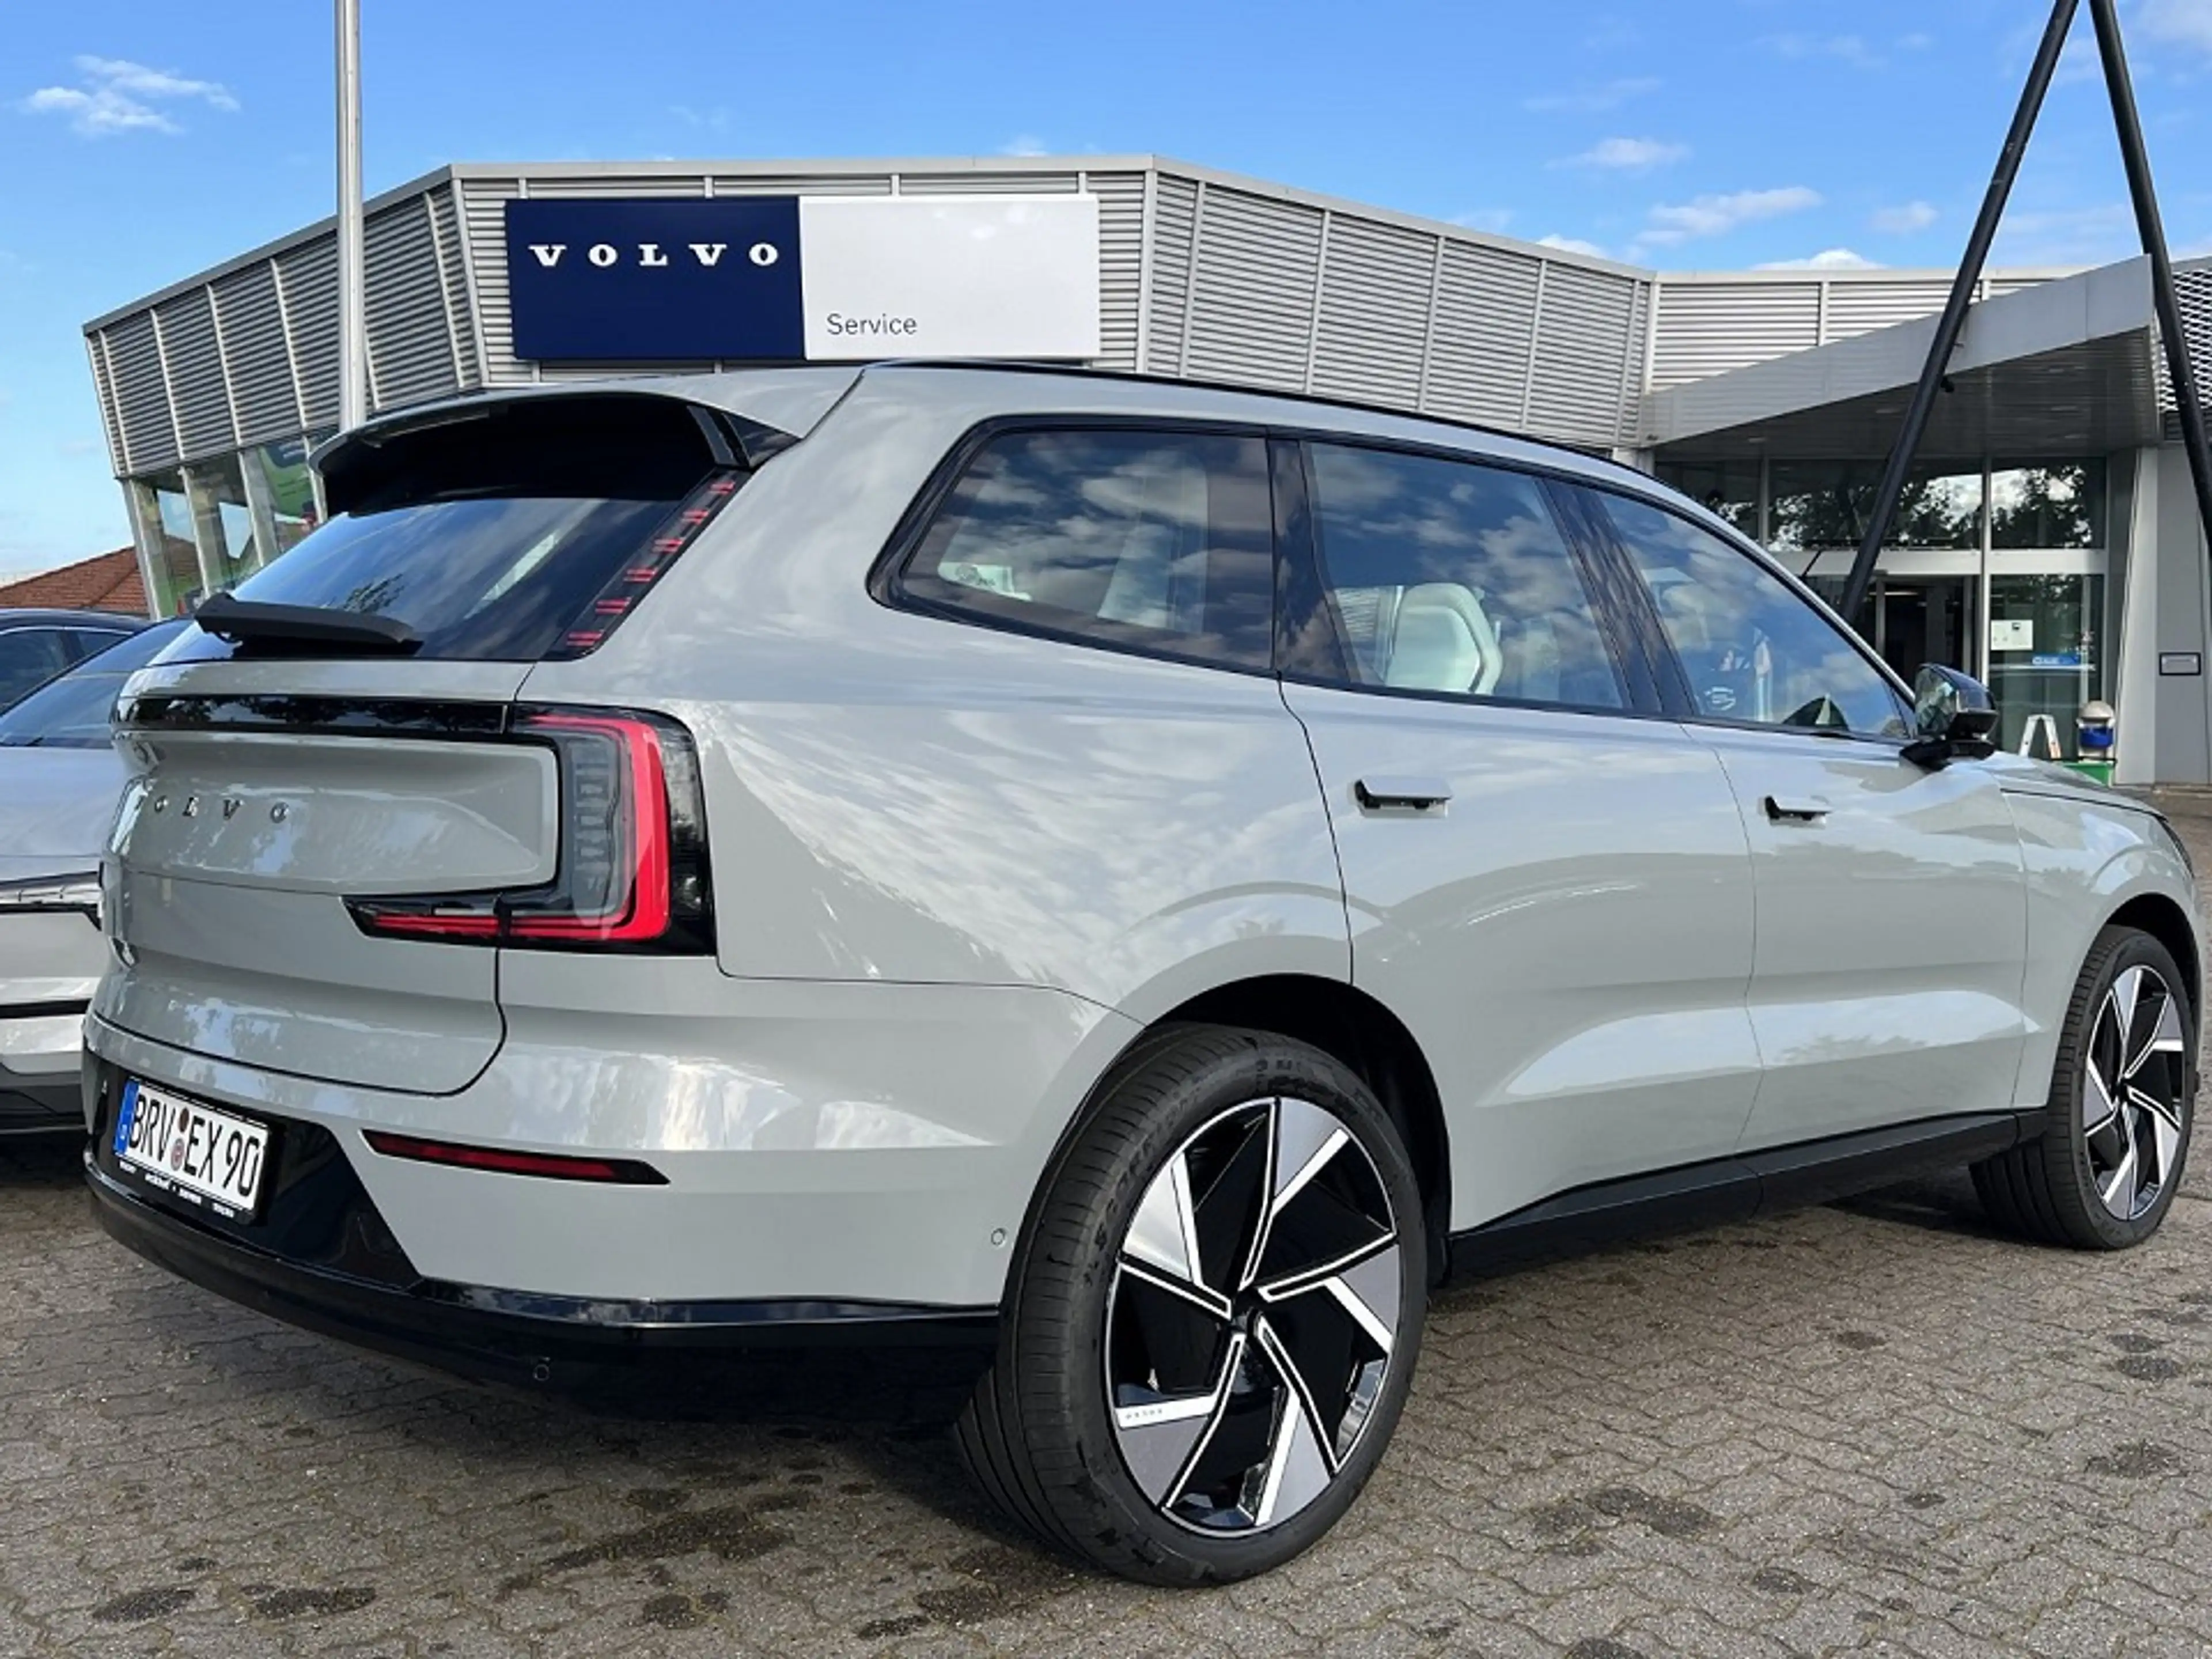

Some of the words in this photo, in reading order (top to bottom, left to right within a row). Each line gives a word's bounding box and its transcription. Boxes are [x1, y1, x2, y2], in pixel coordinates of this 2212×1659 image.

[528, 243, 779, 267] VOLVO
[827, 313, 917, 335] Service
[137, 795, 289, 823] OLVO
[129, 1095, 176, 1162] BRV
[184, 1115, 223, 1183] EX
[222, 1130, 260, 1197] 90
